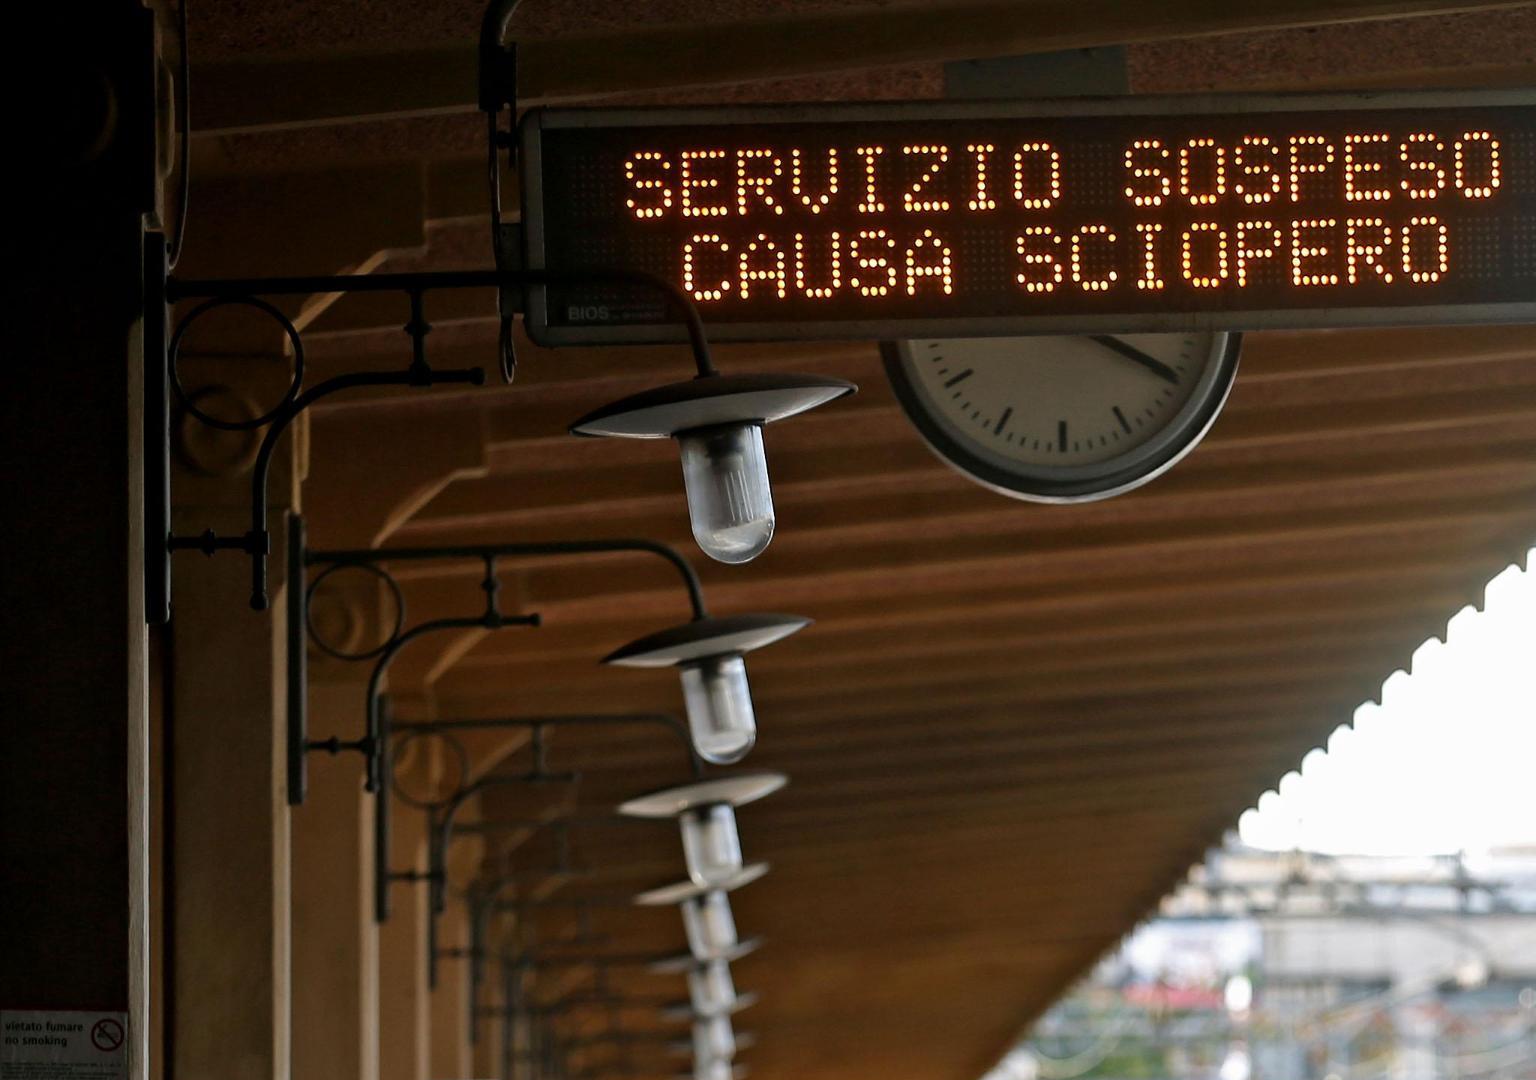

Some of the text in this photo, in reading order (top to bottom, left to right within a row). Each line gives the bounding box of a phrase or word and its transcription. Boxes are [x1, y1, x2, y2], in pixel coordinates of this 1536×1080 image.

[624, 131, 1501, 219] SERVIZIO SOSPESO
[683, 217, 1449, 301] CAUSA SCIOPERO
[567, 305, 610, 321] BIOS
[5, 1021, 84, 1032] vietato fumare
[5, 1036, 68, 1048] no smoking
